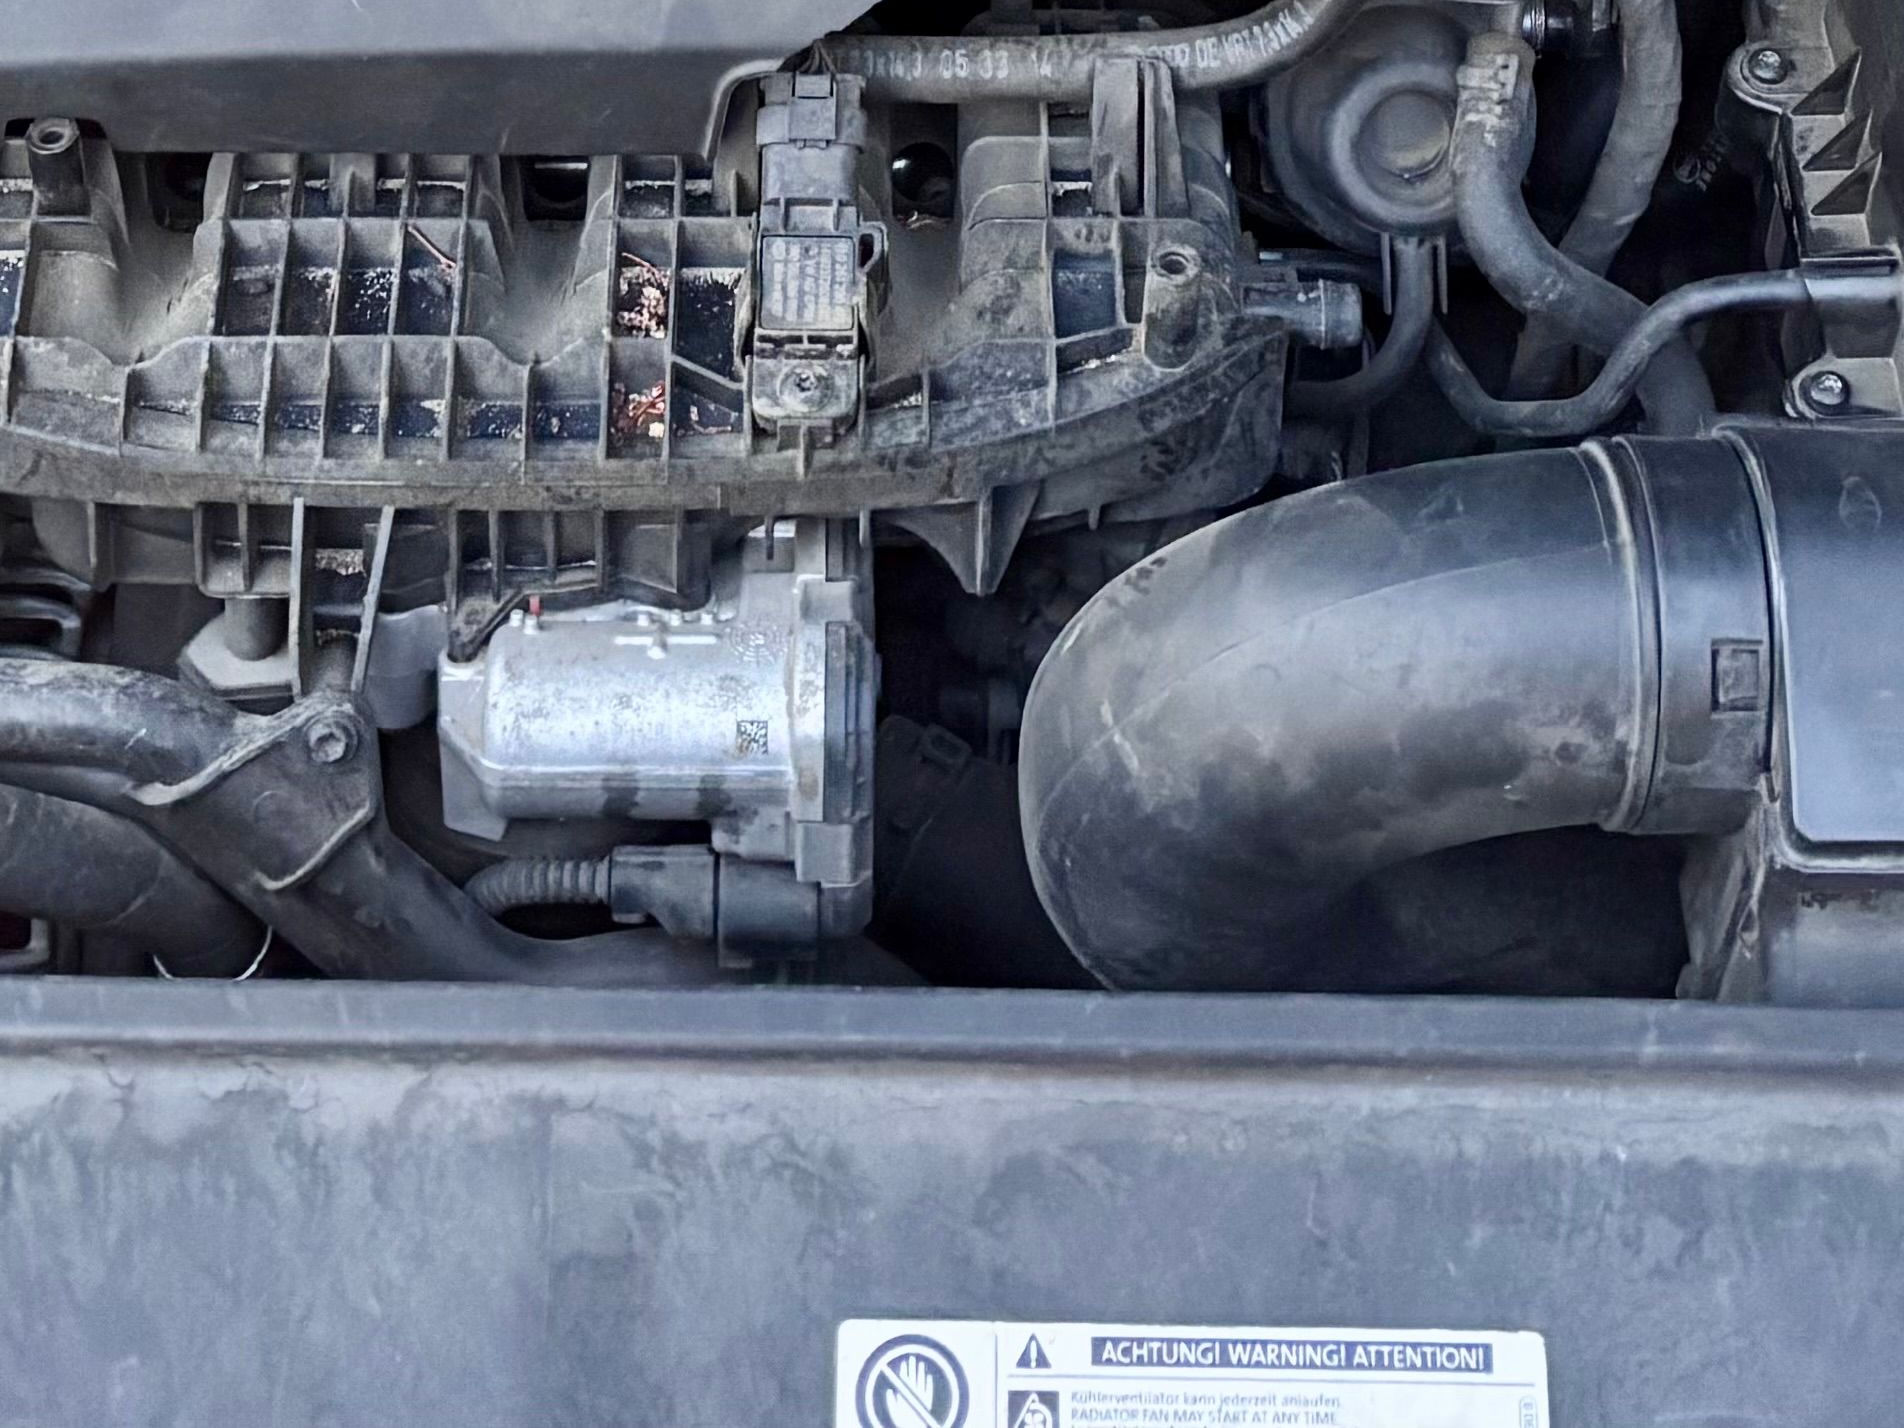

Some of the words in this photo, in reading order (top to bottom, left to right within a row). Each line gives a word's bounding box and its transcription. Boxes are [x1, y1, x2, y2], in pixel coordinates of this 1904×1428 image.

[1101, 1340, 1220, 1365] ACHTUNG!
[1227, 1342, 1347, 1367] WARNING!
[1353, 1344, 1484, 1370] ATTENTION!
[1183, 1391, 1216, 1406] kann
[1143, 1408, 1169, 1422] FAN
[1173, 1409, 1203, 1422] MAY
[1208, 1409, 1246, 1423] START
[1251, 1410, 1268, 1424] AT
[1272, 1410, 1298, 1424] ANY
